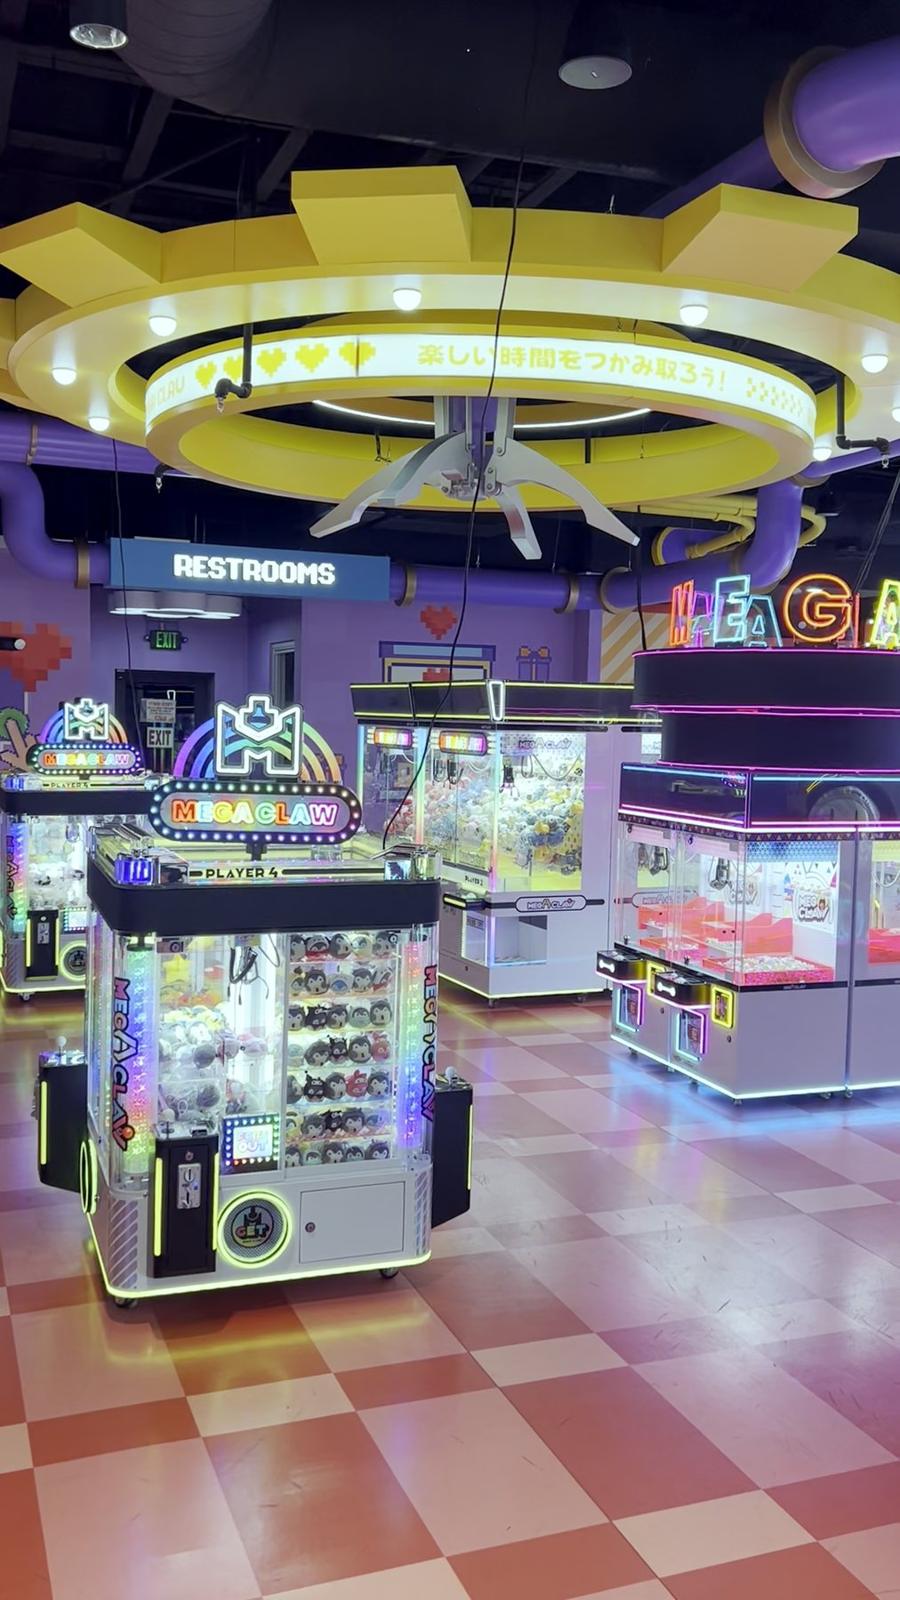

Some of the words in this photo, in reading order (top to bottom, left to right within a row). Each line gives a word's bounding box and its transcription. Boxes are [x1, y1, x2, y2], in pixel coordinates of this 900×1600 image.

[173, 553, 336, 586] RESTROOMS
[155, 631, 178, 649] EXIT
[148, 729, 172, 746] EXIT
[205, 868, 265, 879] PLAYER
[268, 866, 278, 878] 4
